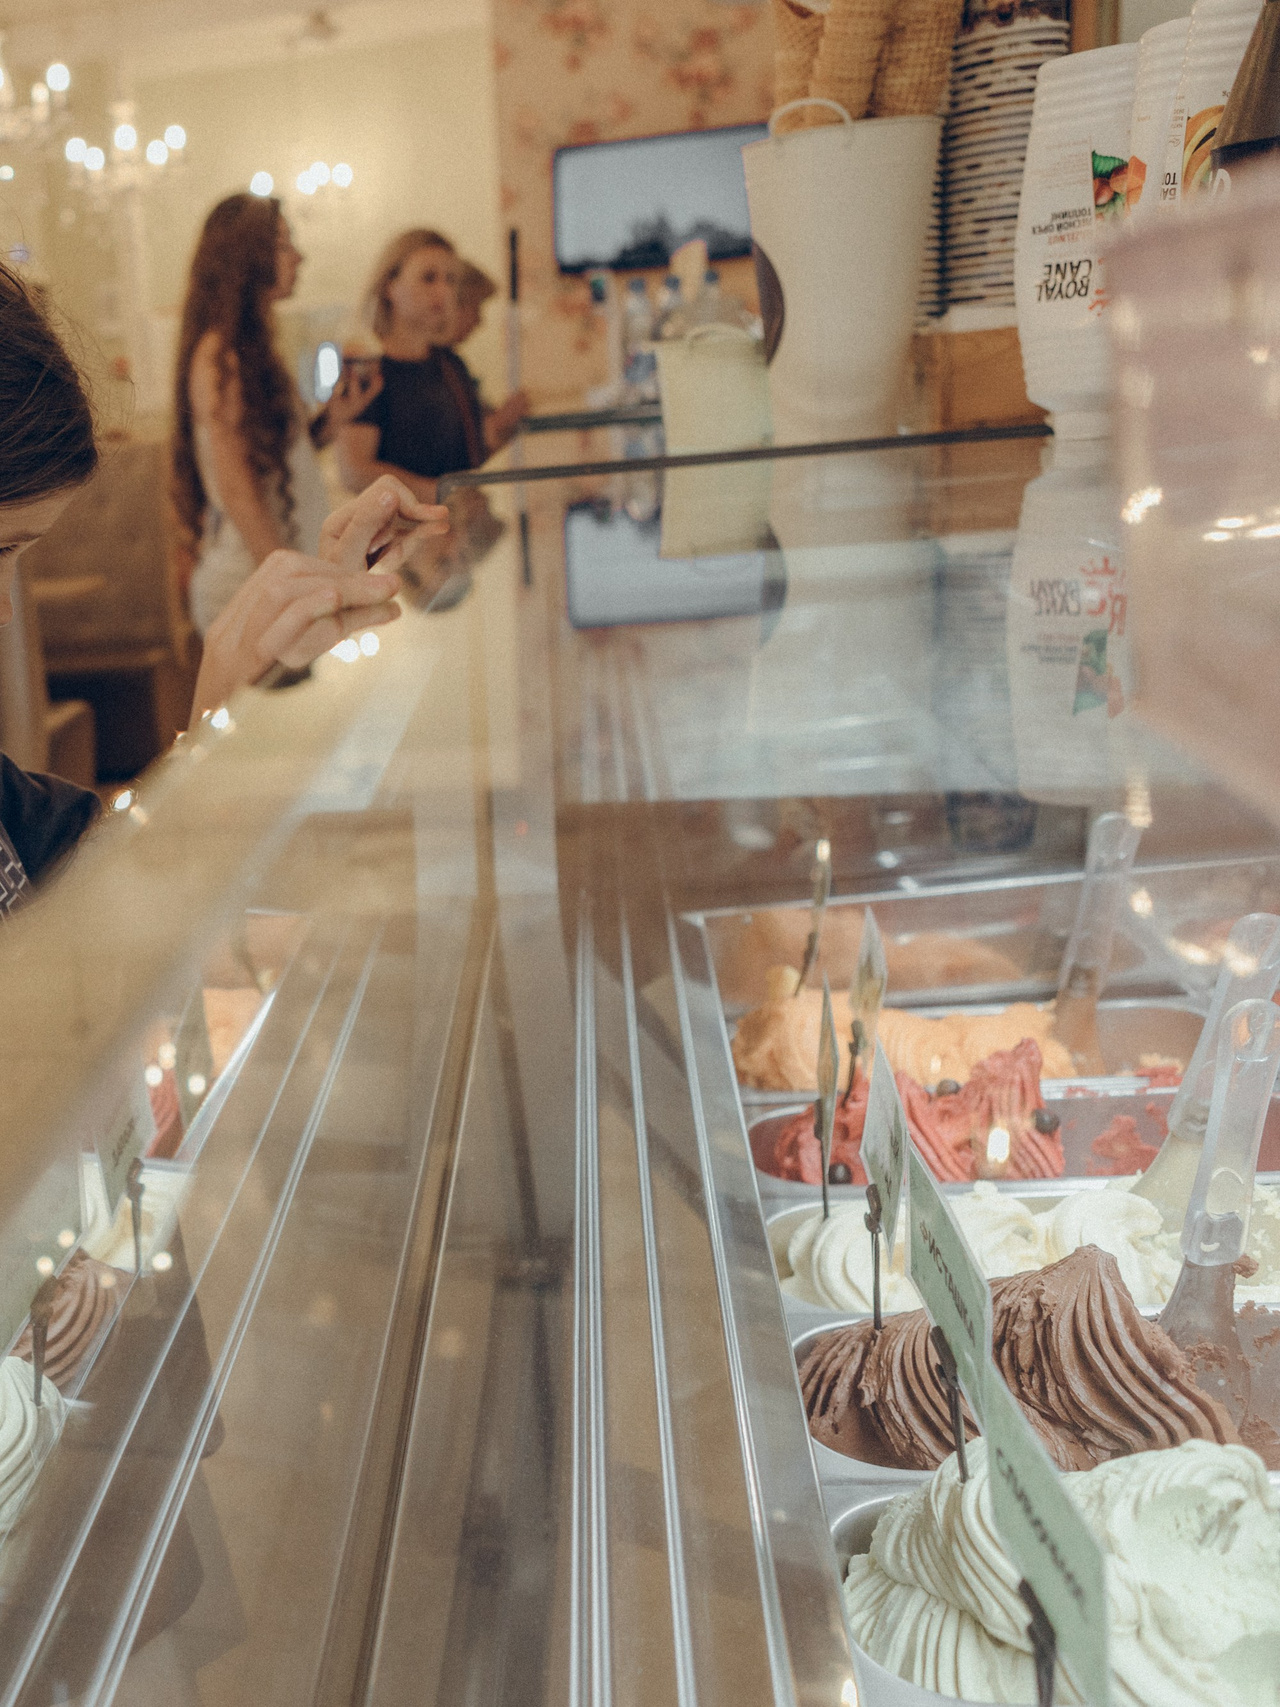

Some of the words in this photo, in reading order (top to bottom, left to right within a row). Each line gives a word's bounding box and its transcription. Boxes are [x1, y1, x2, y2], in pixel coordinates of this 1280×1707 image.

[1043, 259, 1093, 281] CANE
[1035, 276, 1090, 301] ROYAL
[919, 1220, 976, 1349] ФИСТАШКА
